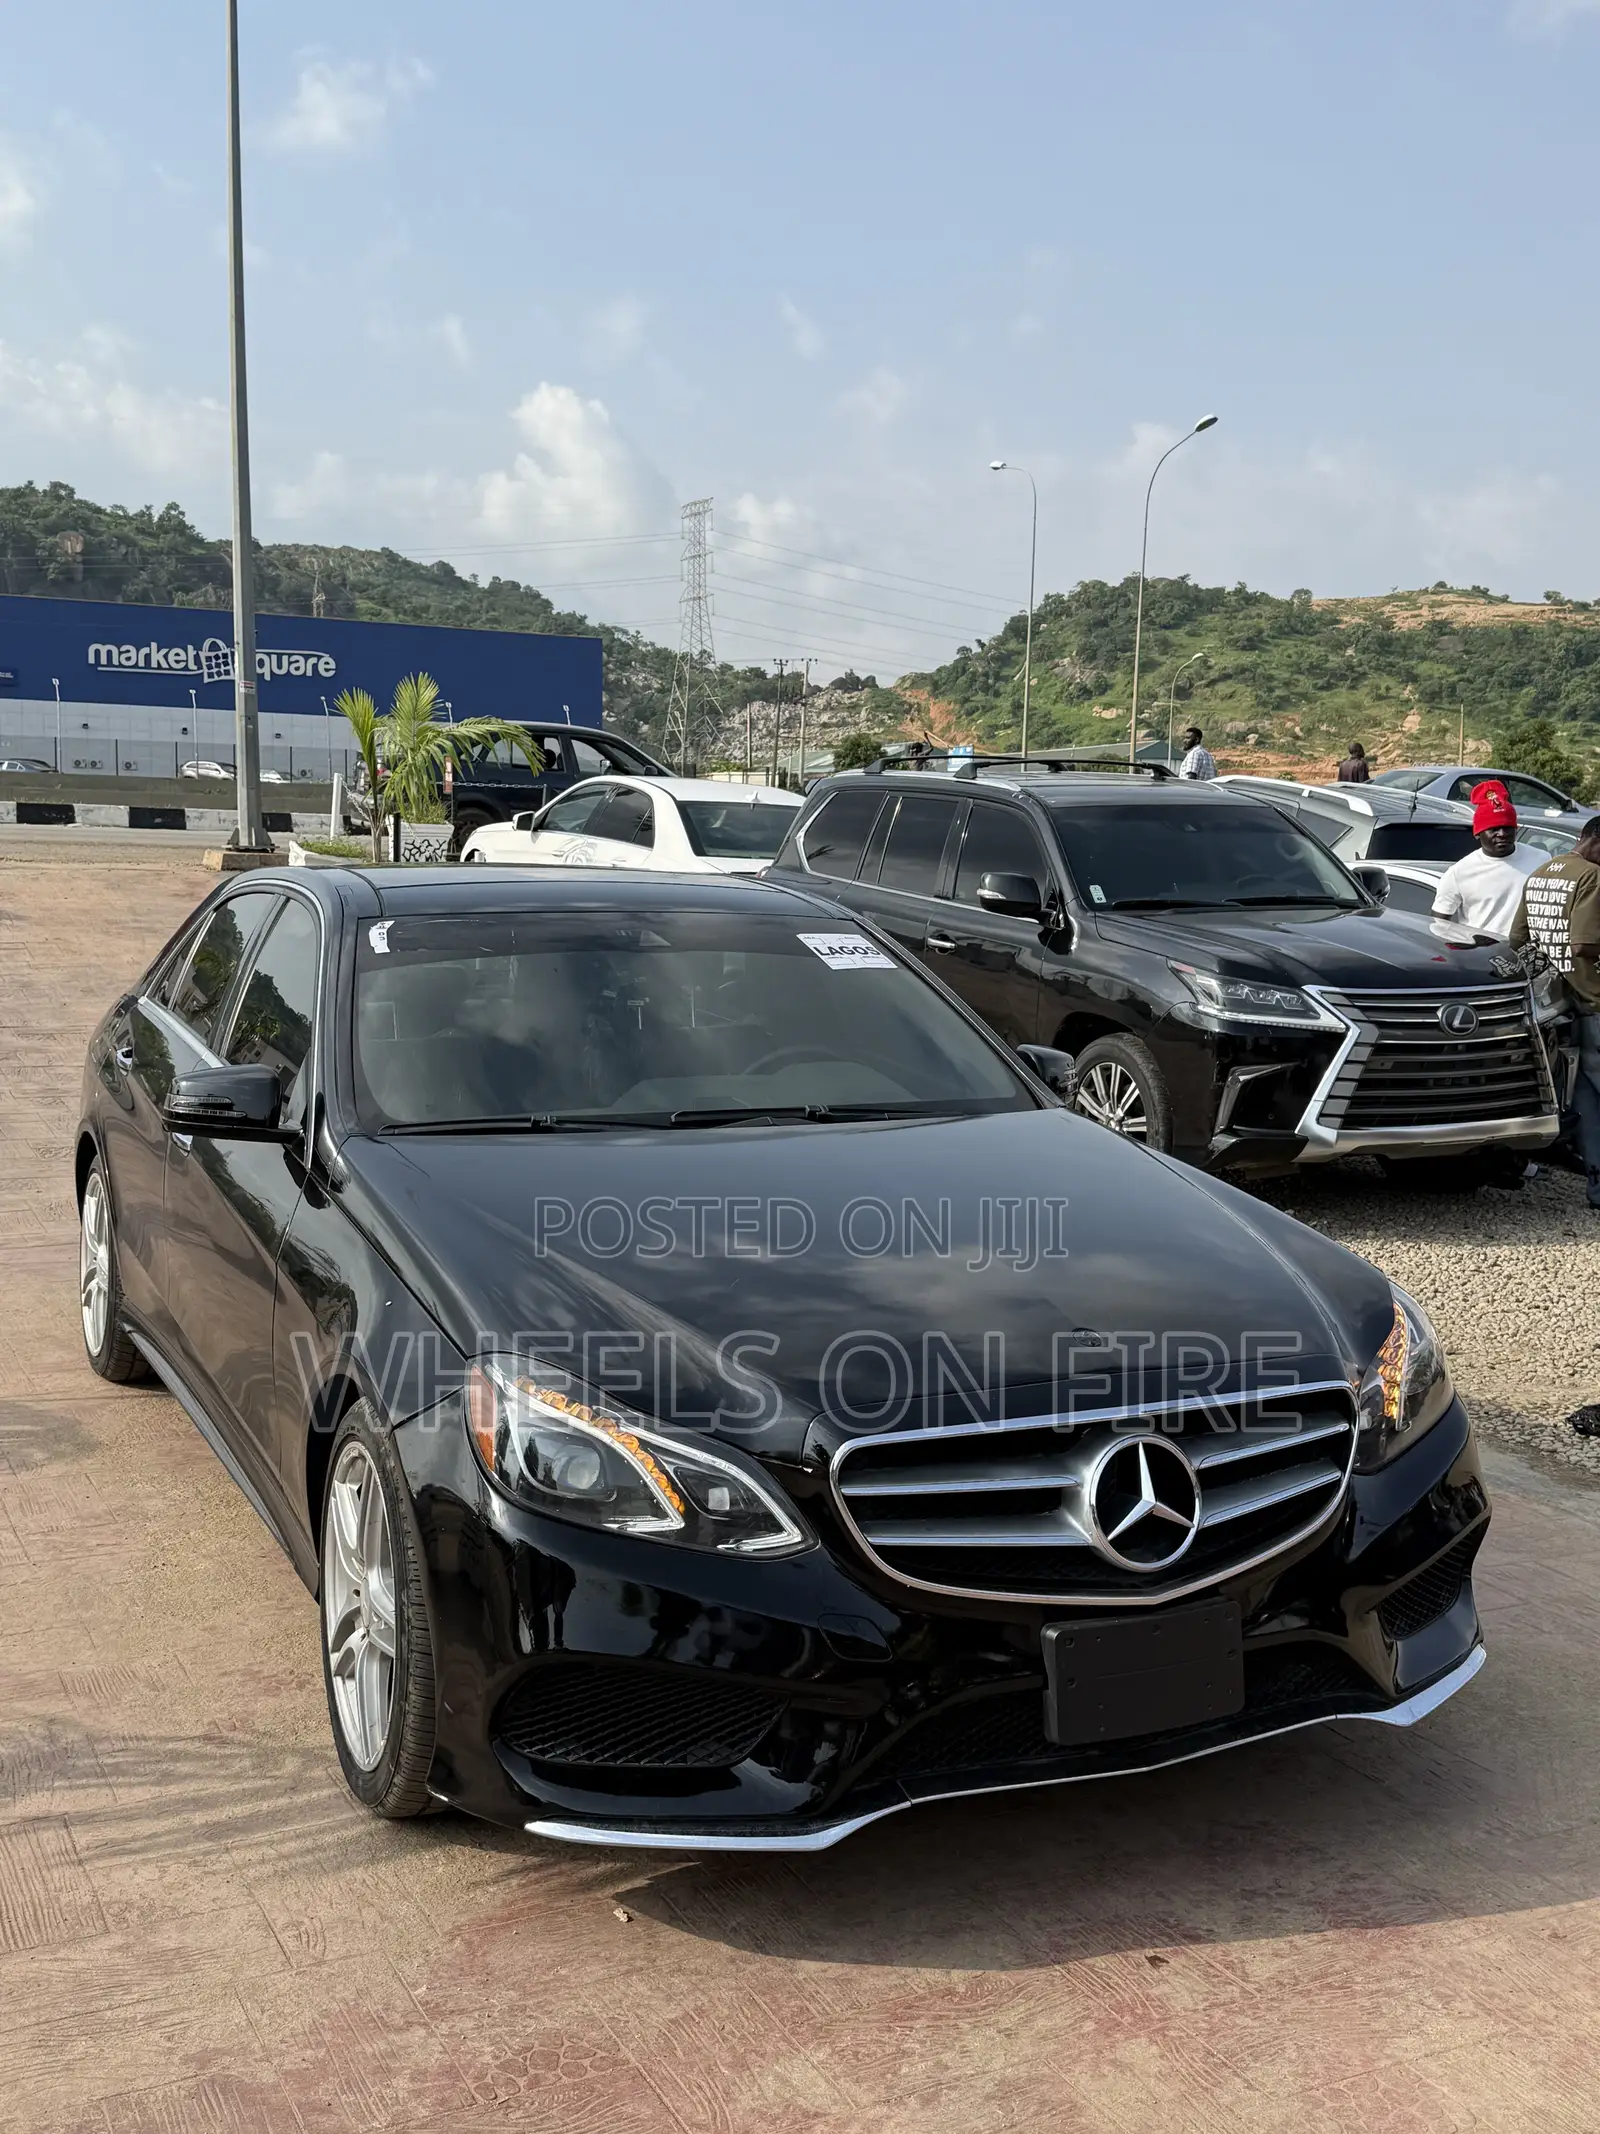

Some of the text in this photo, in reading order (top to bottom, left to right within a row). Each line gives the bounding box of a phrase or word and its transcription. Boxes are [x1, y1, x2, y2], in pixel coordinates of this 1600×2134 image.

[88, 641, 337, 682] market quare
[1547, 878, 1576, 892] PEOPLE
[1552, 932, 1571, 944] ME.
[812, 946, 881, 956] LAGOS
[1549, 946, 1562, 958] BE
[1565, 945, 1572, 958] A
